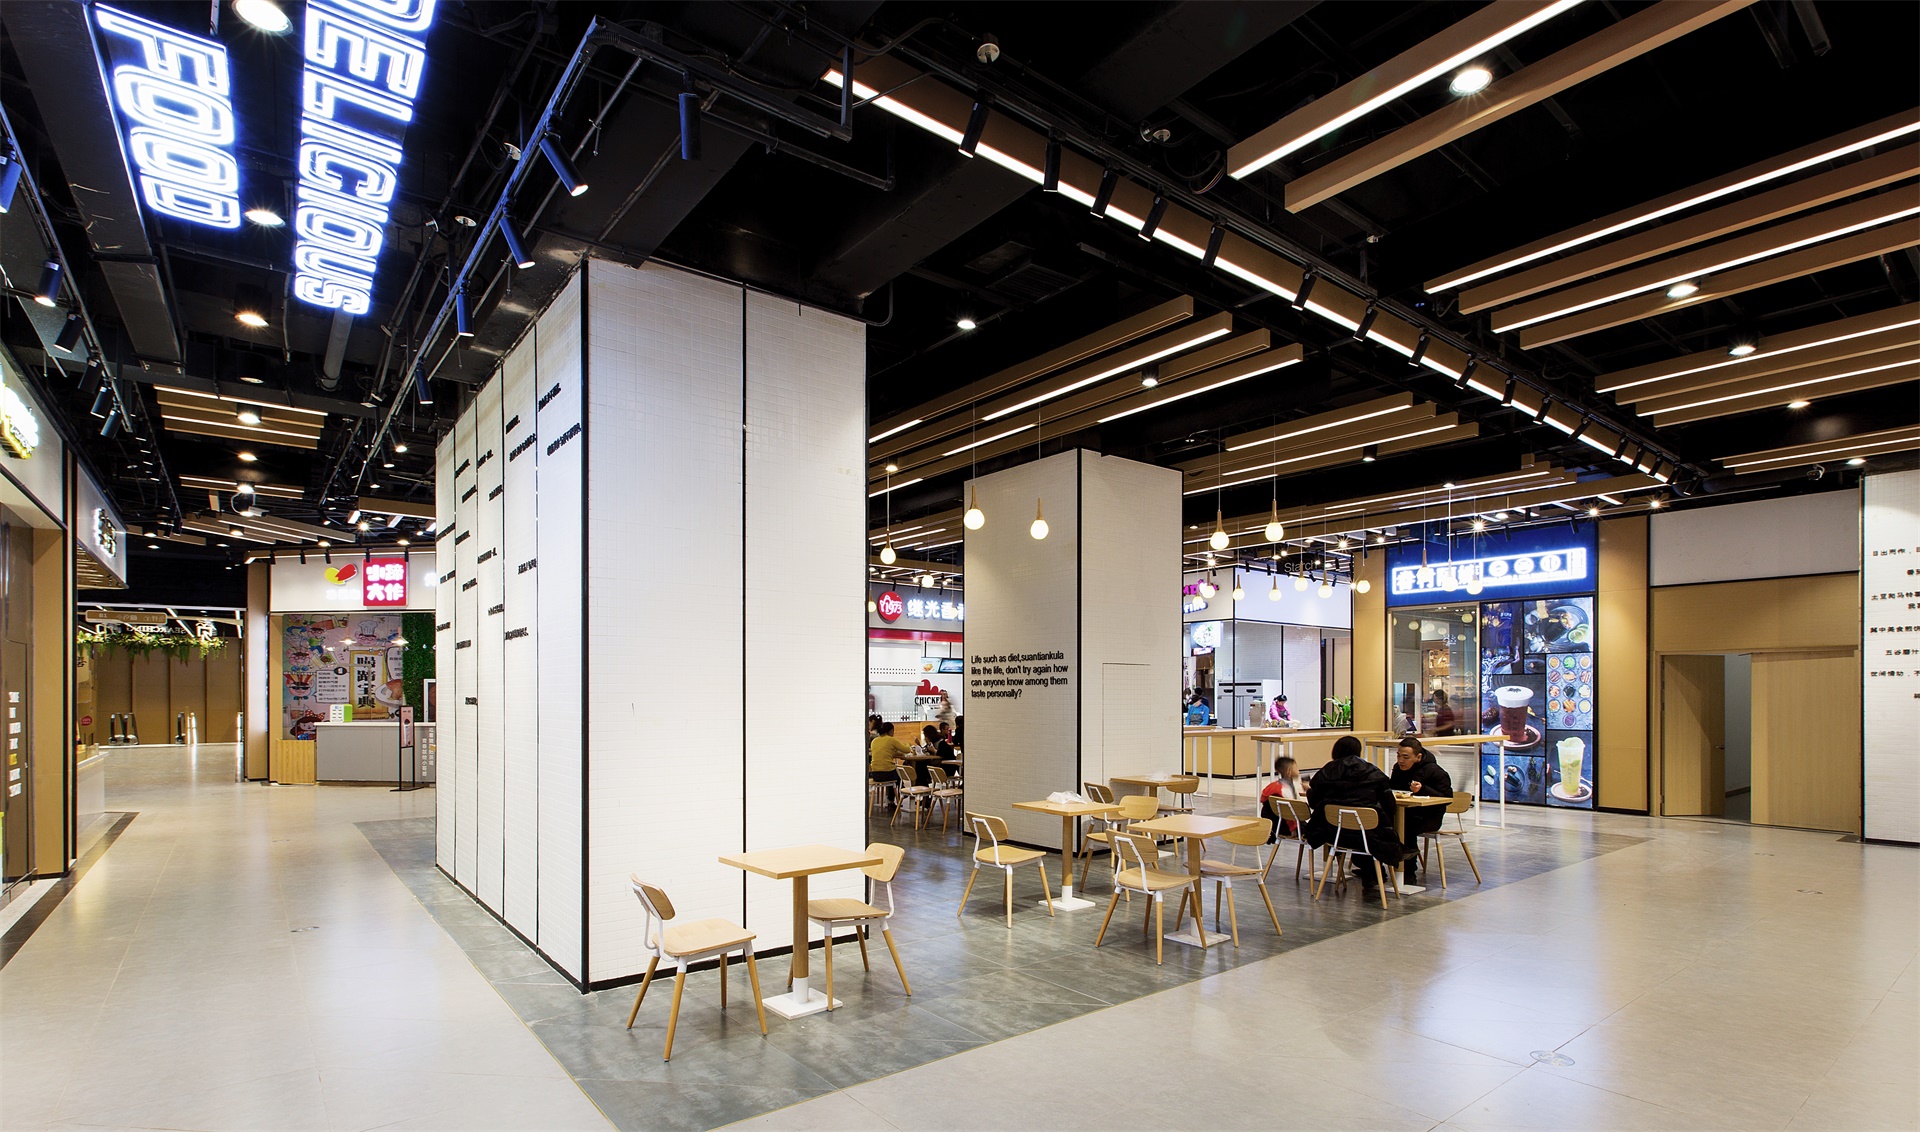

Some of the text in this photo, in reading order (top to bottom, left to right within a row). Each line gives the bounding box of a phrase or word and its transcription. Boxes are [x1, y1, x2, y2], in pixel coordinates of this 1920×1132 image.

[95, 5, 241, 229] FOOD
[366, 582, 404, 601] 大作
[971, 655, 982, 664] Life
[983, 655, 997, 664] such
[971, 664, 1068, 675] like the life, don't try again how
[971, 676, 1068, 688] can anyone know among them
[971, 688, 1022, 699] taste personally?
[914, 696, 943, 706] CHICKE
